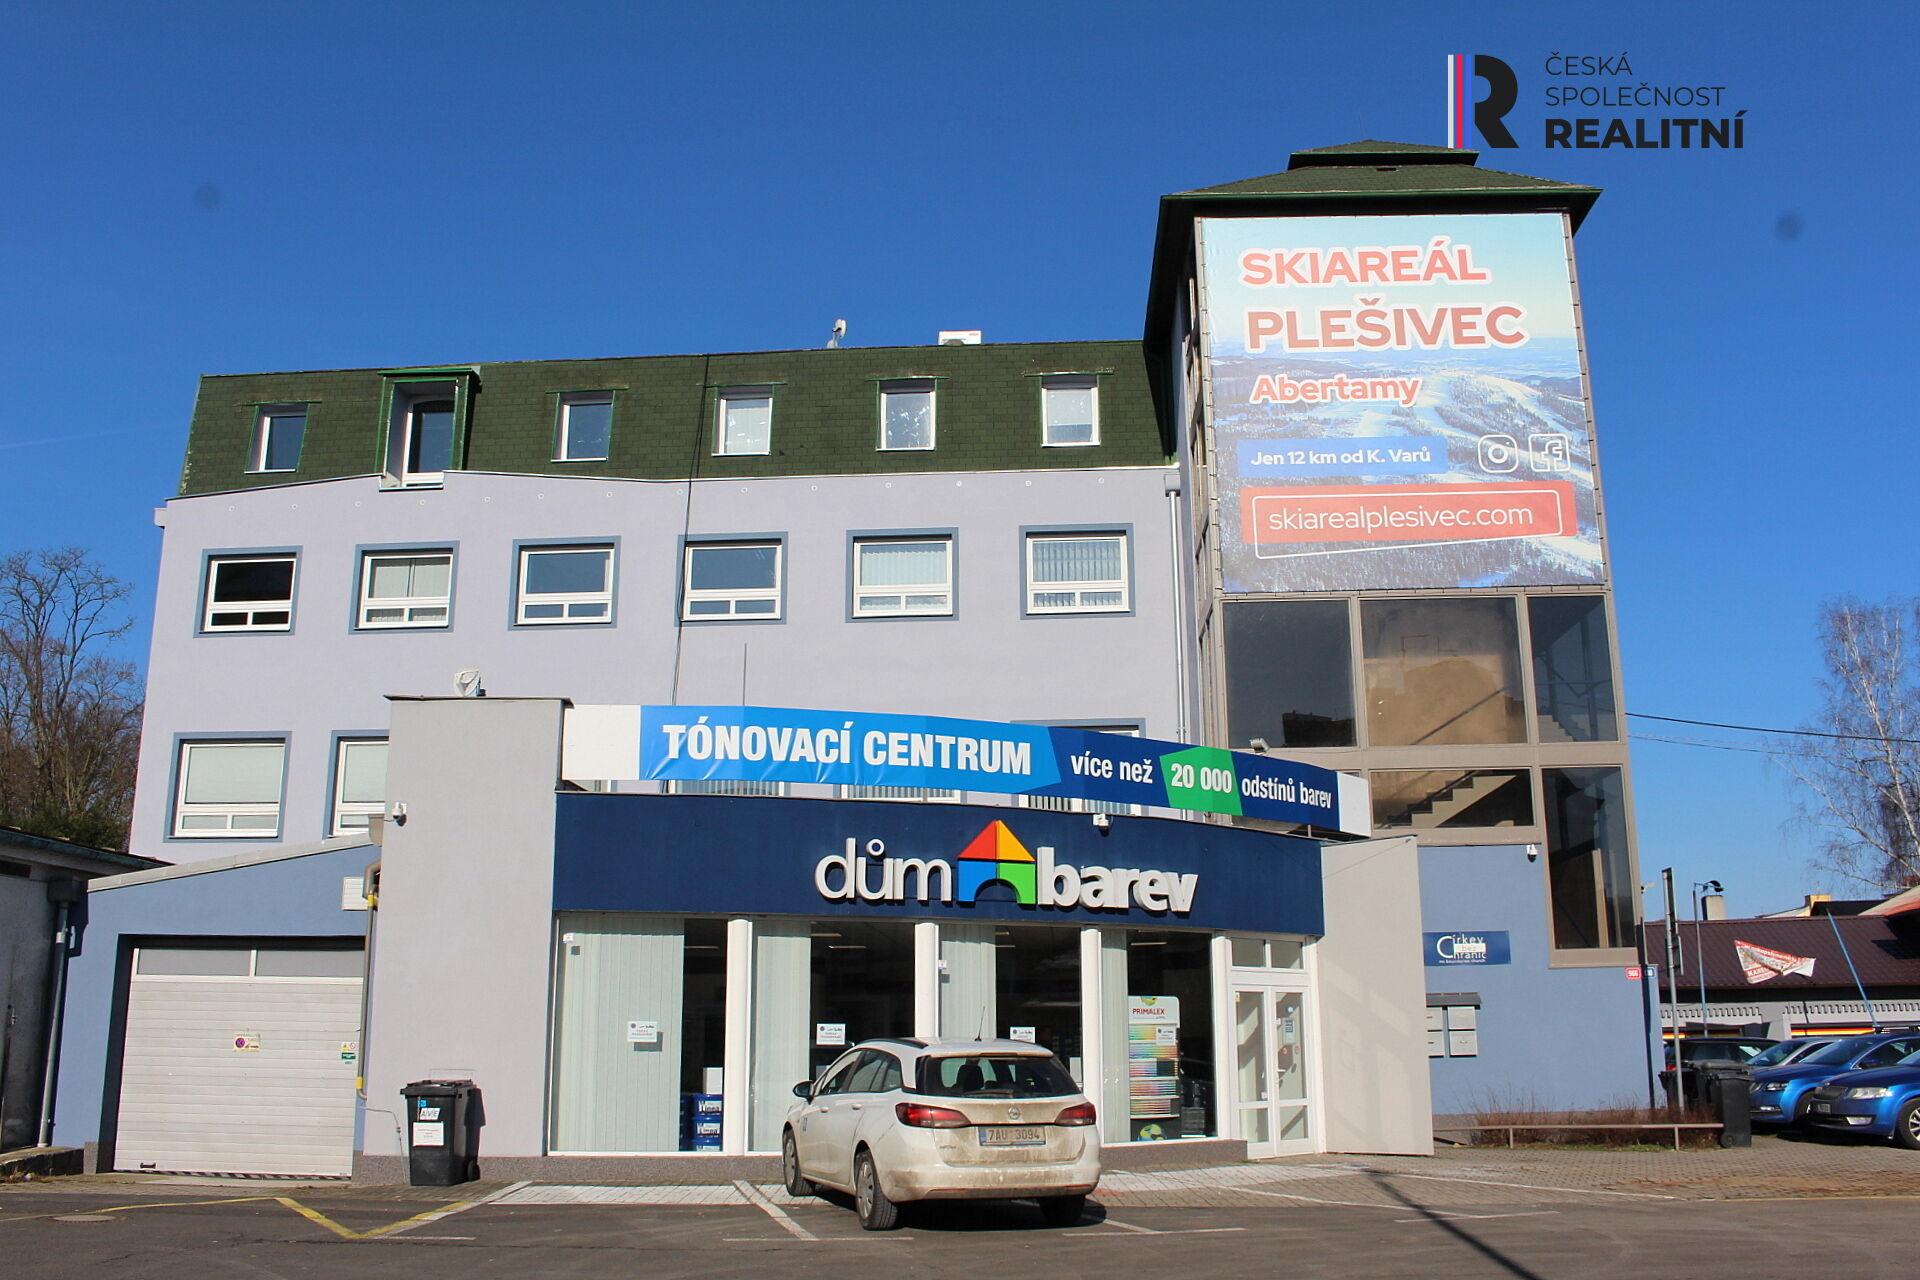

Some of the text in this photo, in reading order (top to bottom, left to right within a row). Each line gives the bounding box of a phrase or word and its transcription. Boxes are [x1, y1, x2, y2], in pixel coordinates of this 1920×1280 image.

[1241, 239, 1488, 285] SKIAREÁL
[1246, 296, 1529, 351] PLEŠIVEC
[1252, 374, 1421, 406] Abertamy
[1250, 446, 1432, 466] Jen 12 km od K. Varů
[1268, 503, 1534, 534] skiarealplesivec.com
[662, 714, 1031, 776] TÓNOVACÍ CENTRUM
[1070, 750, 1332, 810] více než 20 000 odstínů barev
[814, 836, 1199, 913] dům barev
[988, 1128, 1040, 1141] 7AU 3094
